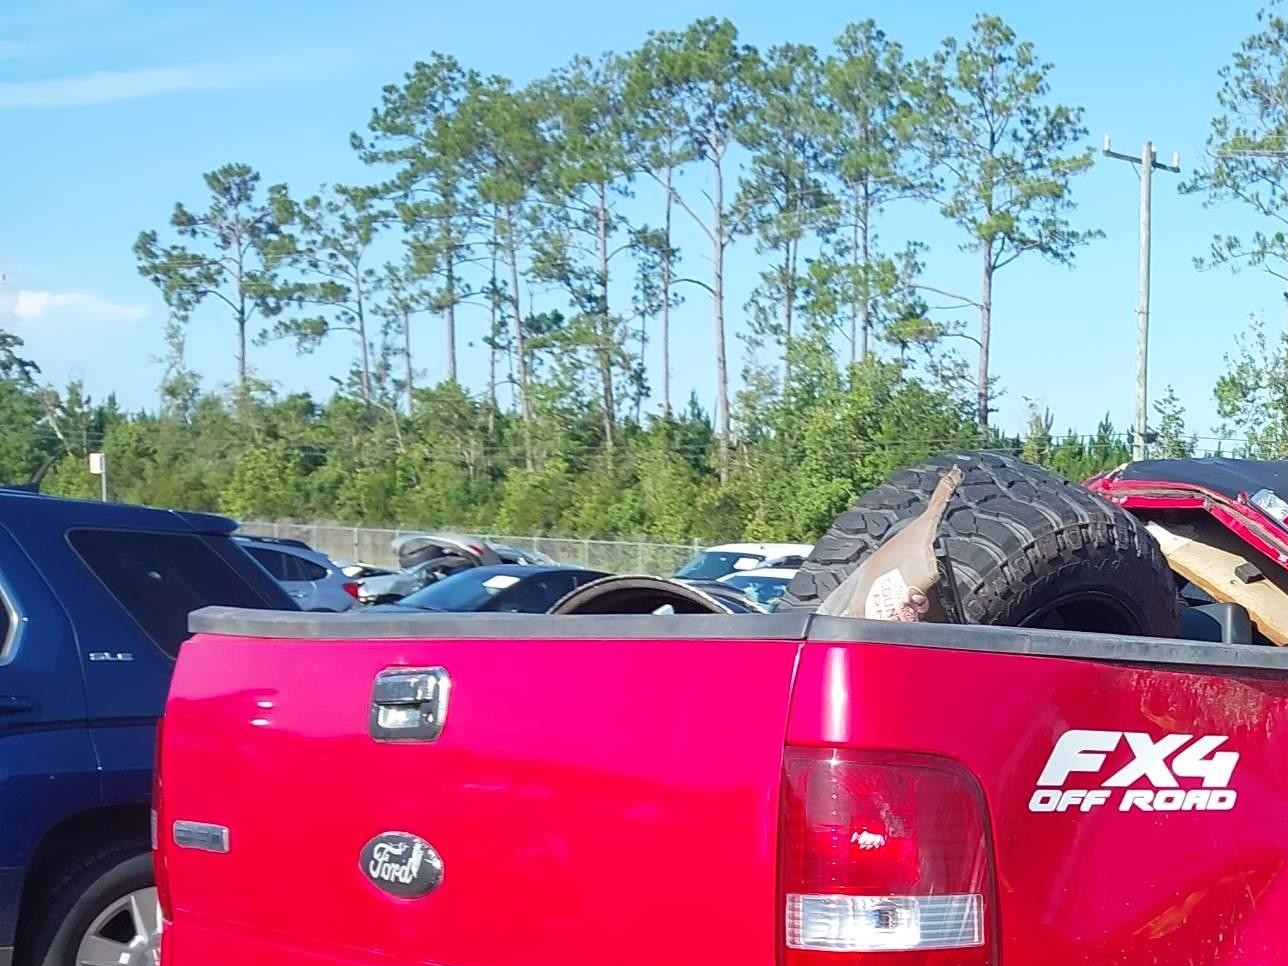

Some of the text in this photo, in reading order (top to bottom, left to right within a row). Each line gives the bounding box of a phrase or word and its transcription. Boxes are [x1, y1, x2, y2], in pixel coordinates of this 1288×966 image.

[1036, 729, 1240, 788] FX4
[1028, 789, 1237, 812] OFF ROAD
[368, 842, 424, 884] Ford
